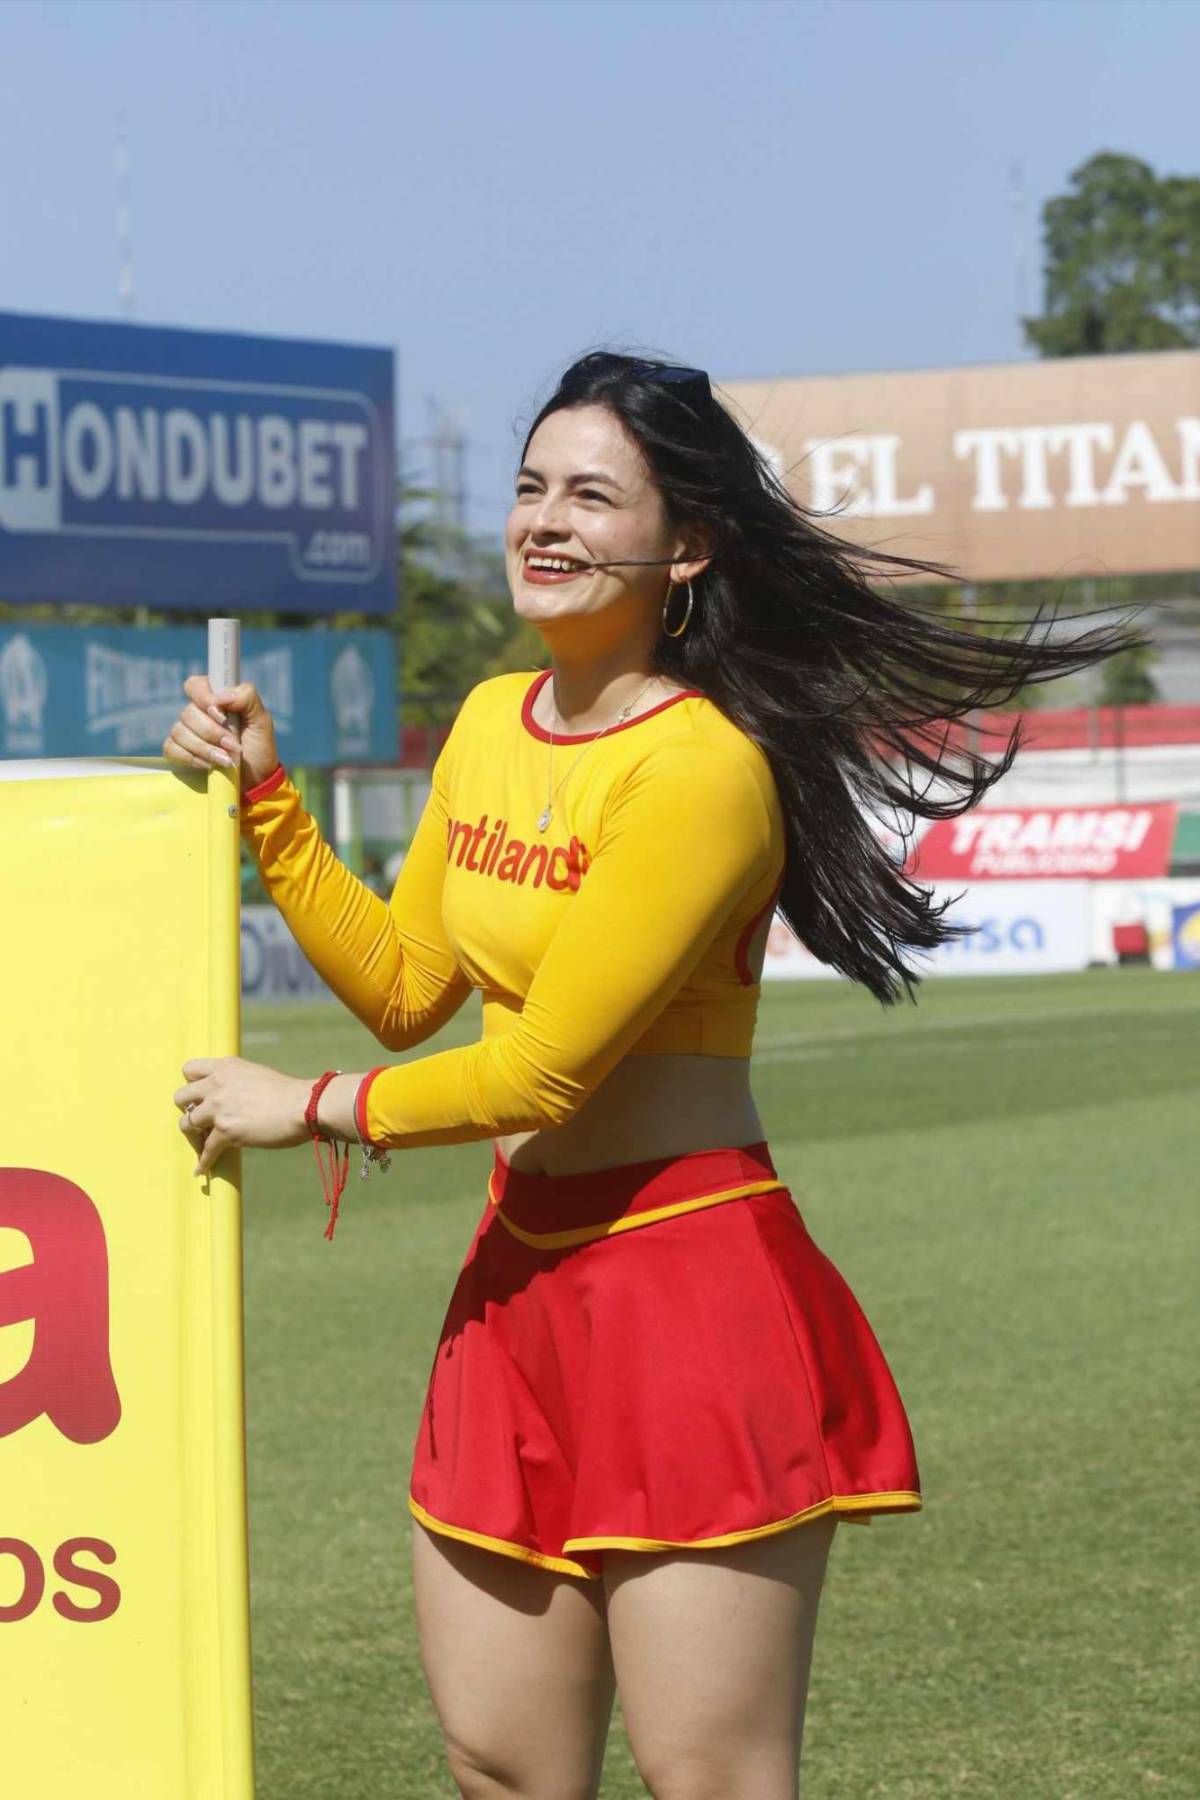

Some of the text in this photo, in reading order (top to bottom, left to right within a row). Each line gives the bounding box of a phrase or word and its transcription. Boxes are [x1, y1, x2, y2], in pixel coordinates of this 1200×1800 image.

[3, 401, 367, 509] HONDUBET
[805, 434, 934, 518] EL
[305, 532, 370, 566] .com
